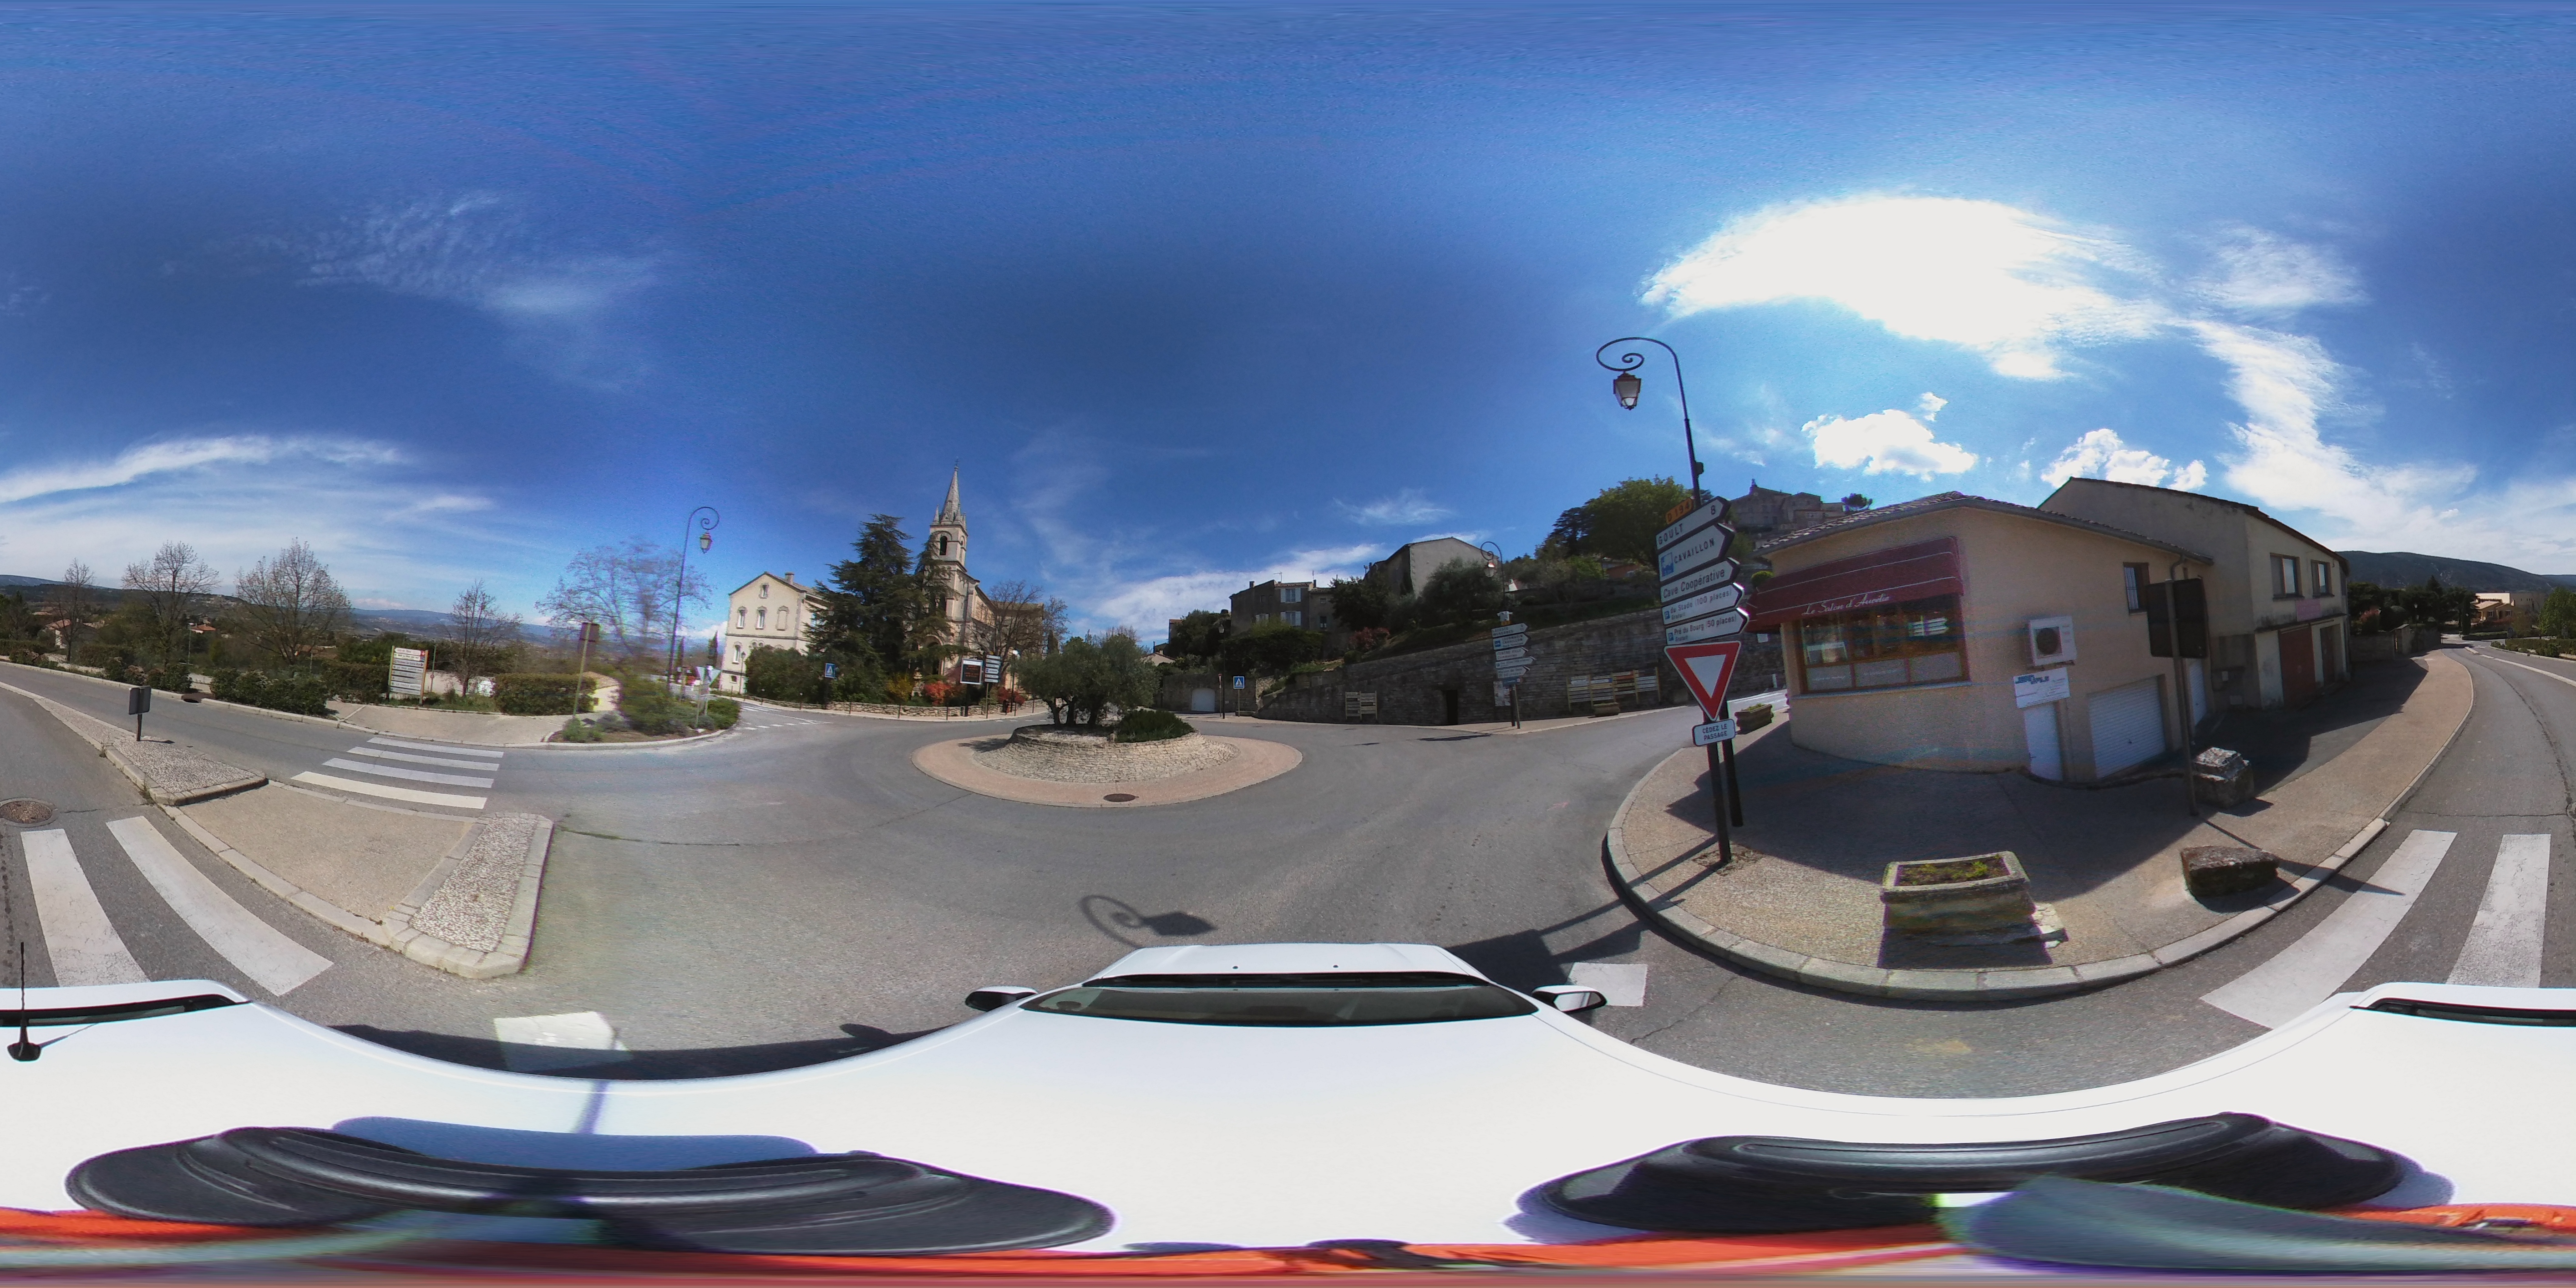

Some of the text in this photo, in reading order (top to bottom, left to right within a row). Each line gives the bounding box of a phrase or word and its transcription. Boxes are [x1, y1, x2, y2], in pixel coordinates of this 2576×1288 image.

[1667, 501, 1689, 522] D 194
[1658, 505, 1716, 545] GOULT 8
[1674, 538, 1714, 564] CAVAILLON
[1663, 569, 1725, 598] Cave Coopérative
[1678, 602, 1693, 611] Stade
[1801, 603, 1815, 616] Le
[1818, 601, 1844, 614] Salon
[1702, 725, 1719, 734] CÉDEZ
[1704, 731, 1728, 741] PASSAGE
